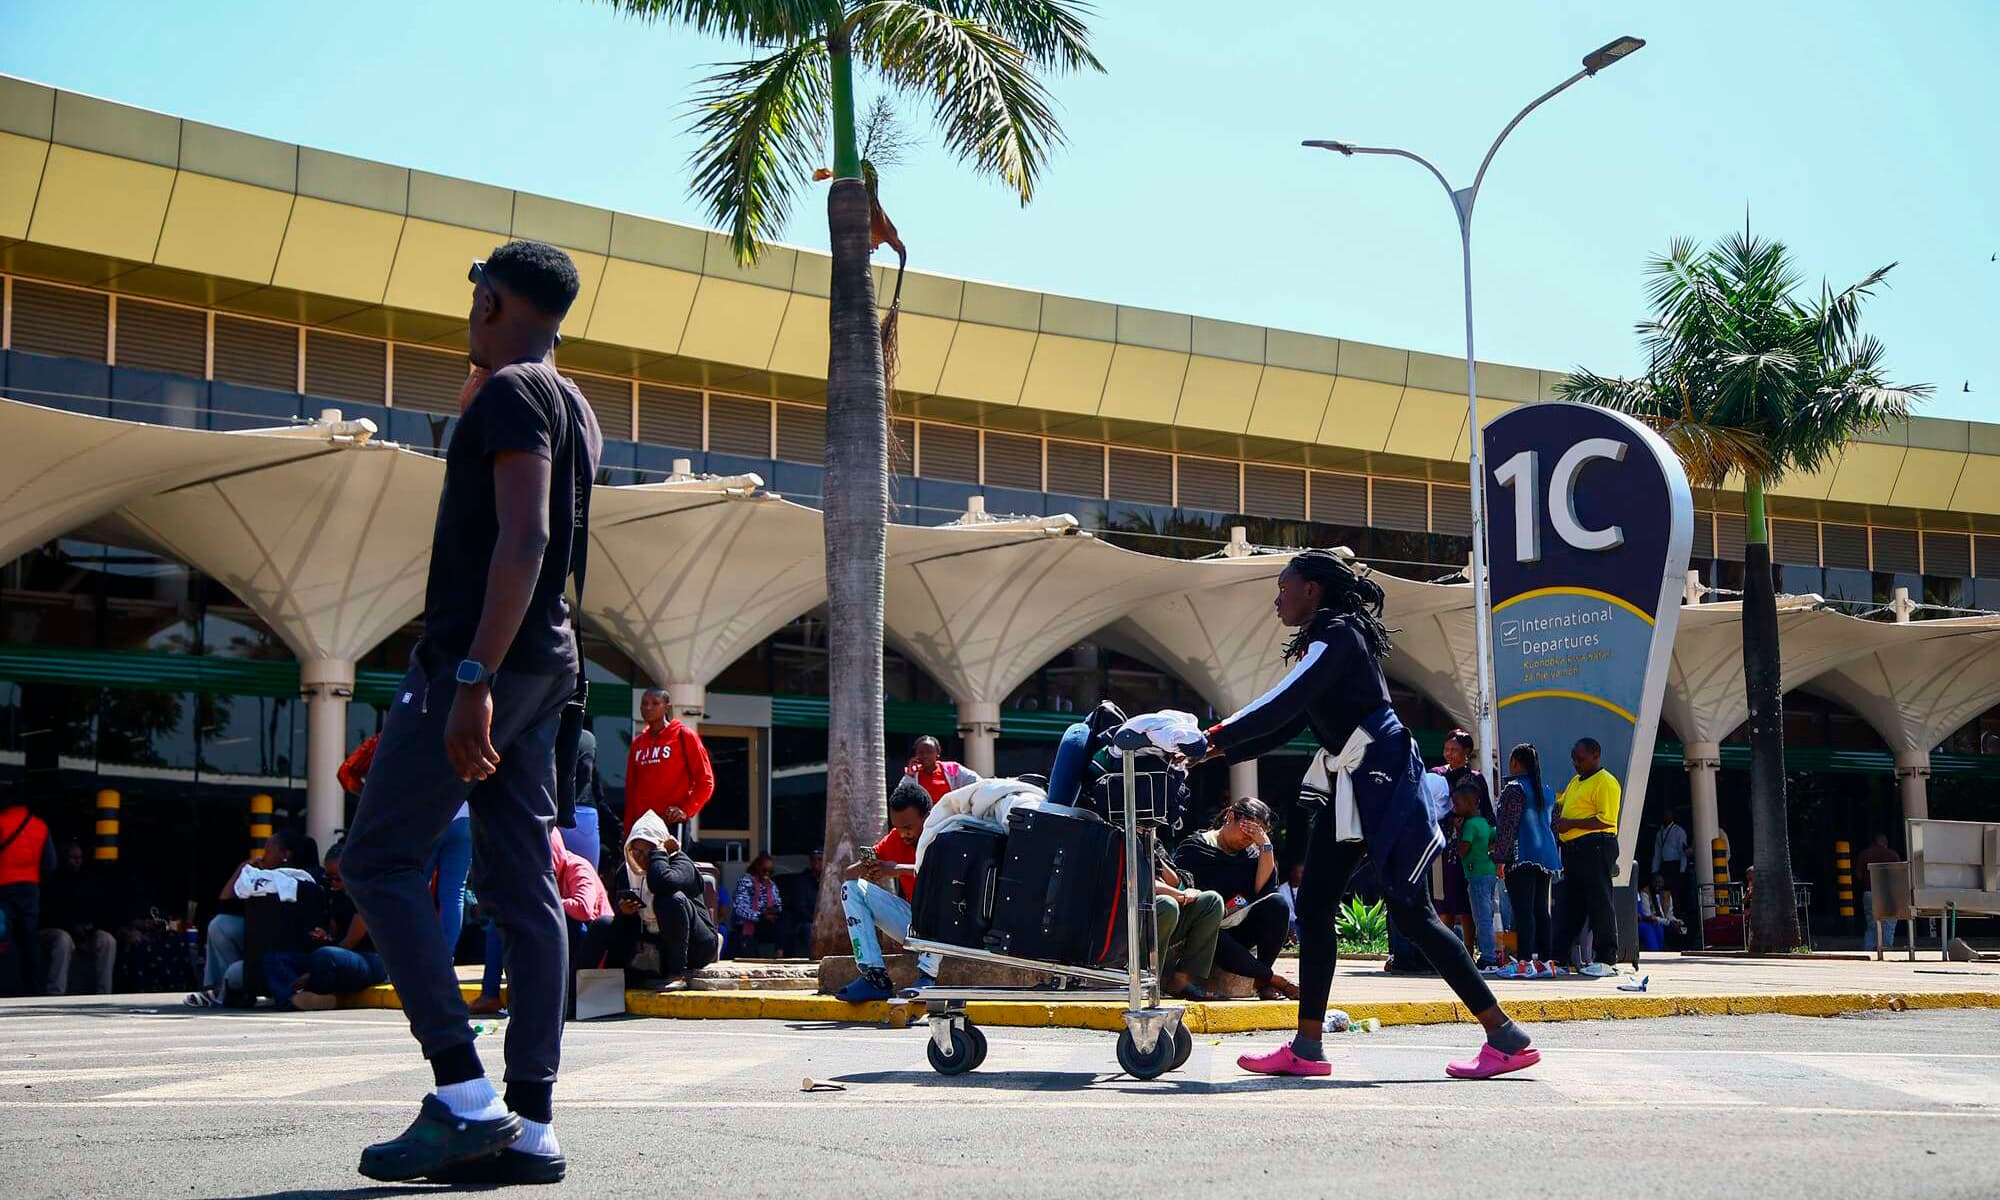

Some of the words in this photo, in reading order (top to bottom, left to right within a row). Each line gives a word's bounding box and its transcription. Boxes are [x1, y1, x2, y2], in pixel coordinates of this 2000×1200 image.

[1493, 438, 1628, 563] 1C
[1521, 604, 1613, 633] International
[1522, 633, 1600, 656] Departures
